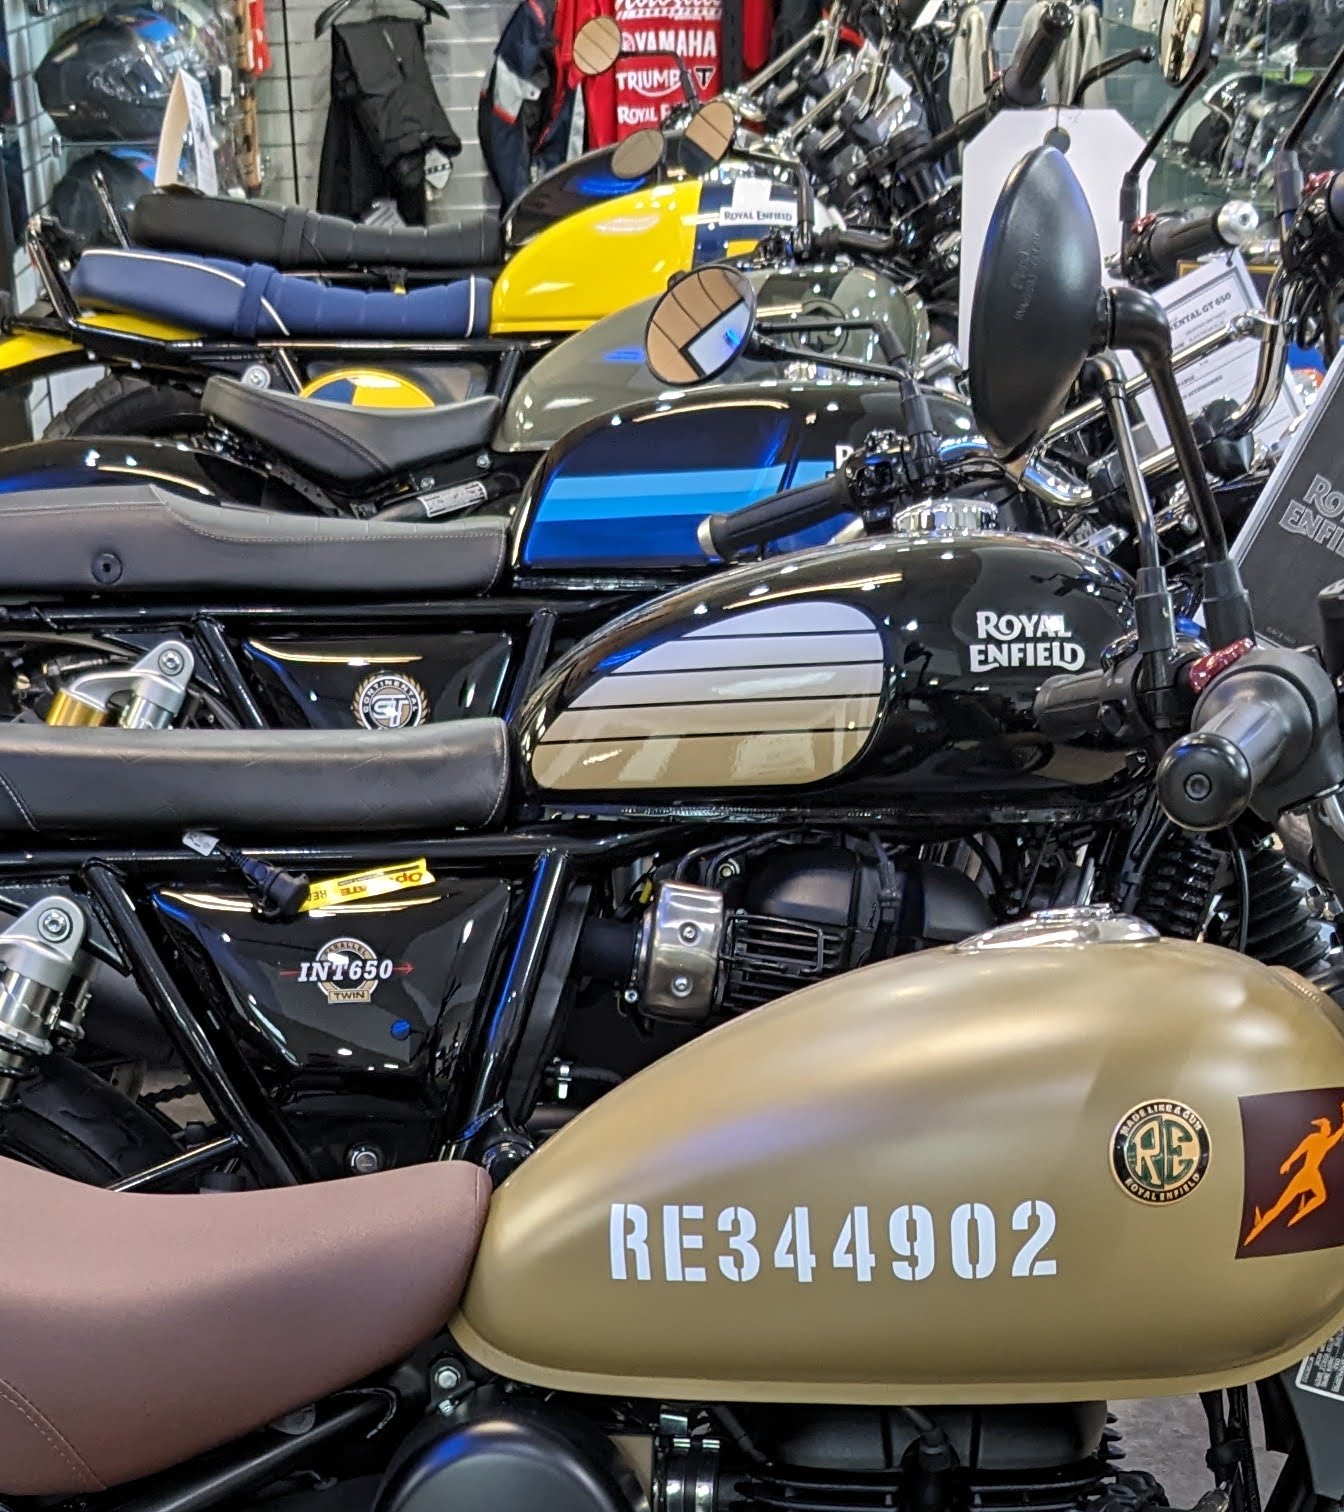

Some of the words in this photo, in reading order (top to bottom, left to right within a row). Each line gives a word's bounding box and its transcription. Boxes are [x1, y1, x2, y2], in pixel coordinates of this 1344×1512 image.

[635, 29, 717, 57] YAMAHA
[616, 68, 691, 96] TRIUMP
[617, 105, 658, 125] ROYAL
[724, 210, 754, 221] ROYAL
[756, 210, 793, 221] ENFIELD
[1202, 300, 1215, 313] GT
[1215, 292, 1232, 306] 650
[976, 611, 1072, 641] ROYAL
[969, 641, 1085, 673] ENFIELD
[362, 679, 417, 713] CONTINENTAL
[297, 959, 394, 982] INT650
[334, 991, 365, 1000] TWIN
[1119, 1109, 1147, 1136] MADE
[1147, 1104, 1172, 1114] LIKE
[1182, 1110, 1202, 1131] GUN
[1124, 1178, 1156, 1201] ROYAL
[1159, 1173, 1200, 1201] ENFIELD
[610, 1200, 1056, 1283] RE344902
